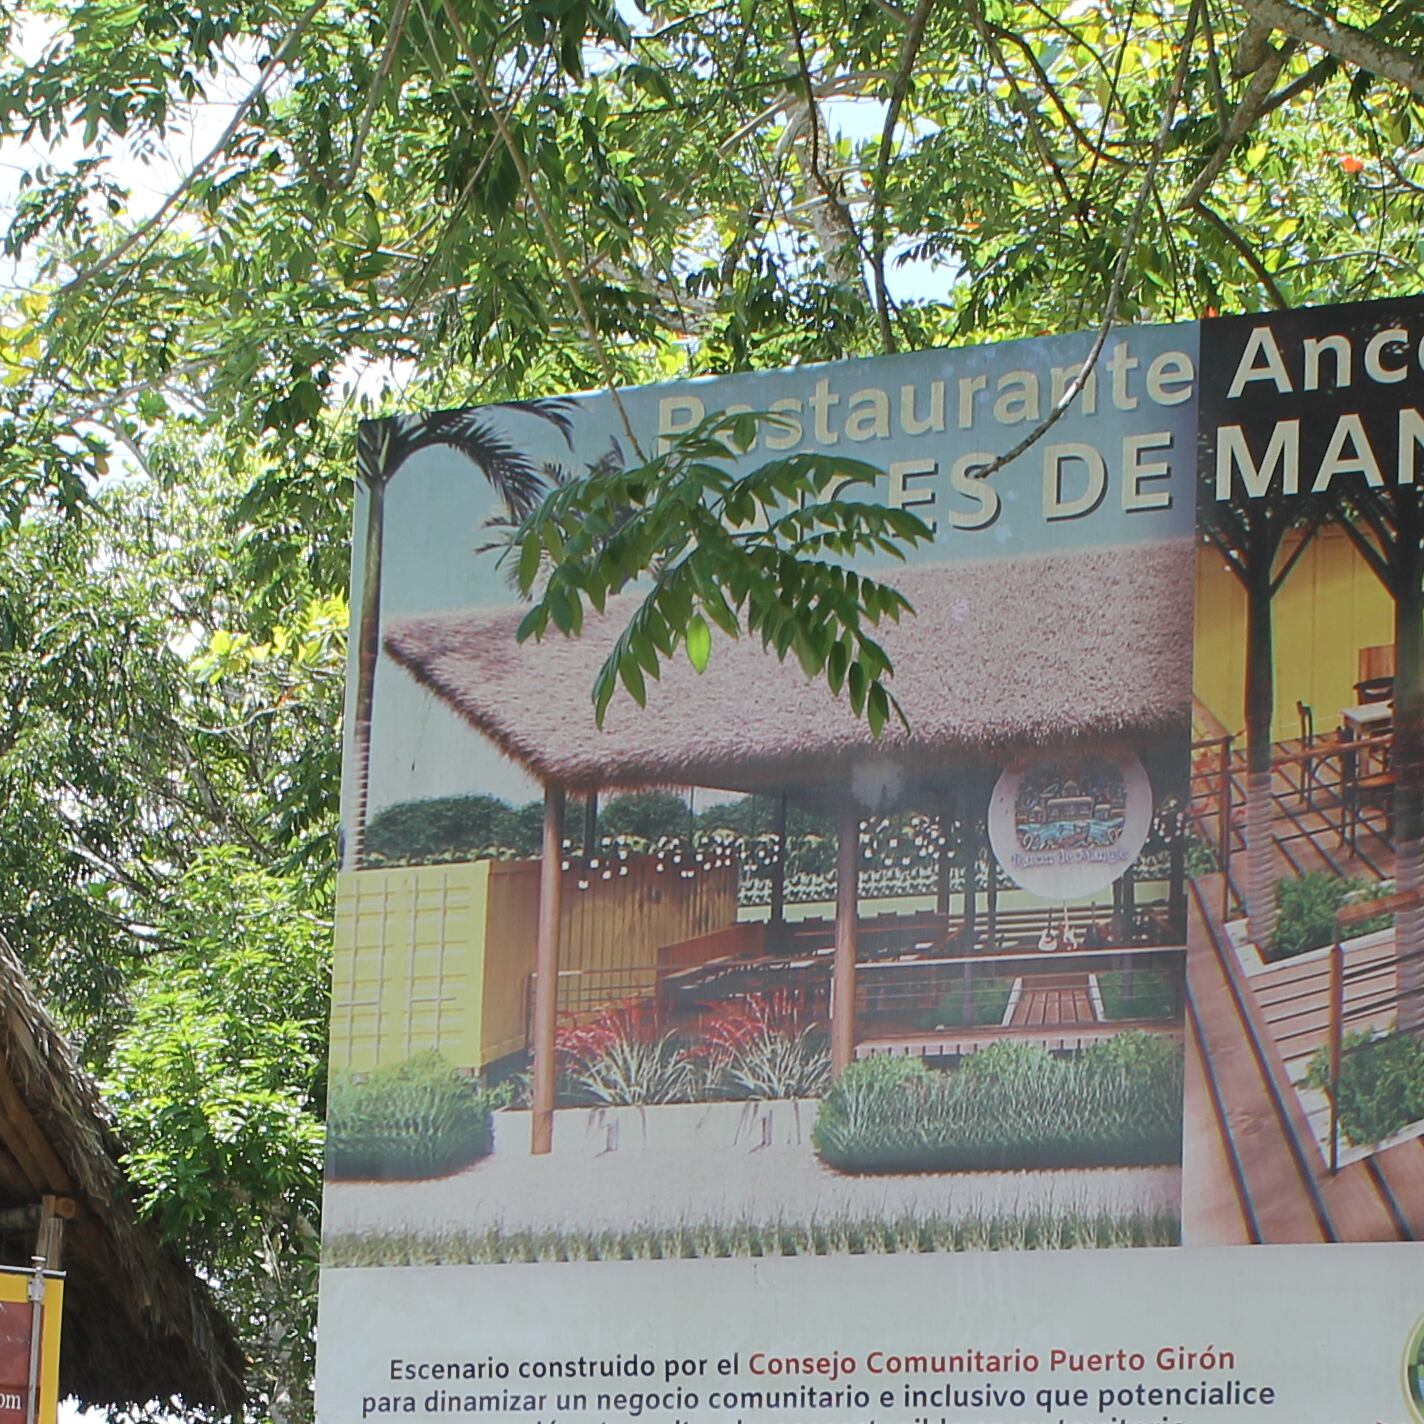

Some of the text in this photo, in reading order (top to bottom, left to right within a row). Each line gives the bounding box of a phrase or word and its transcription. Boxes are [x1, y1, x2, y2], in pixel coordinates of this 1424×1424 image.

[657, 342, 1195, 459] Restaurante
[1042, 431, 1174, 524] DE
[389, 1344, 1236, 1382] Escenario construido por el Consejo Comunitario Puerto Girón
[361, 1380, 1276, 1418] para dinamizar un negocio comunitario e inclusivo que potencialice
